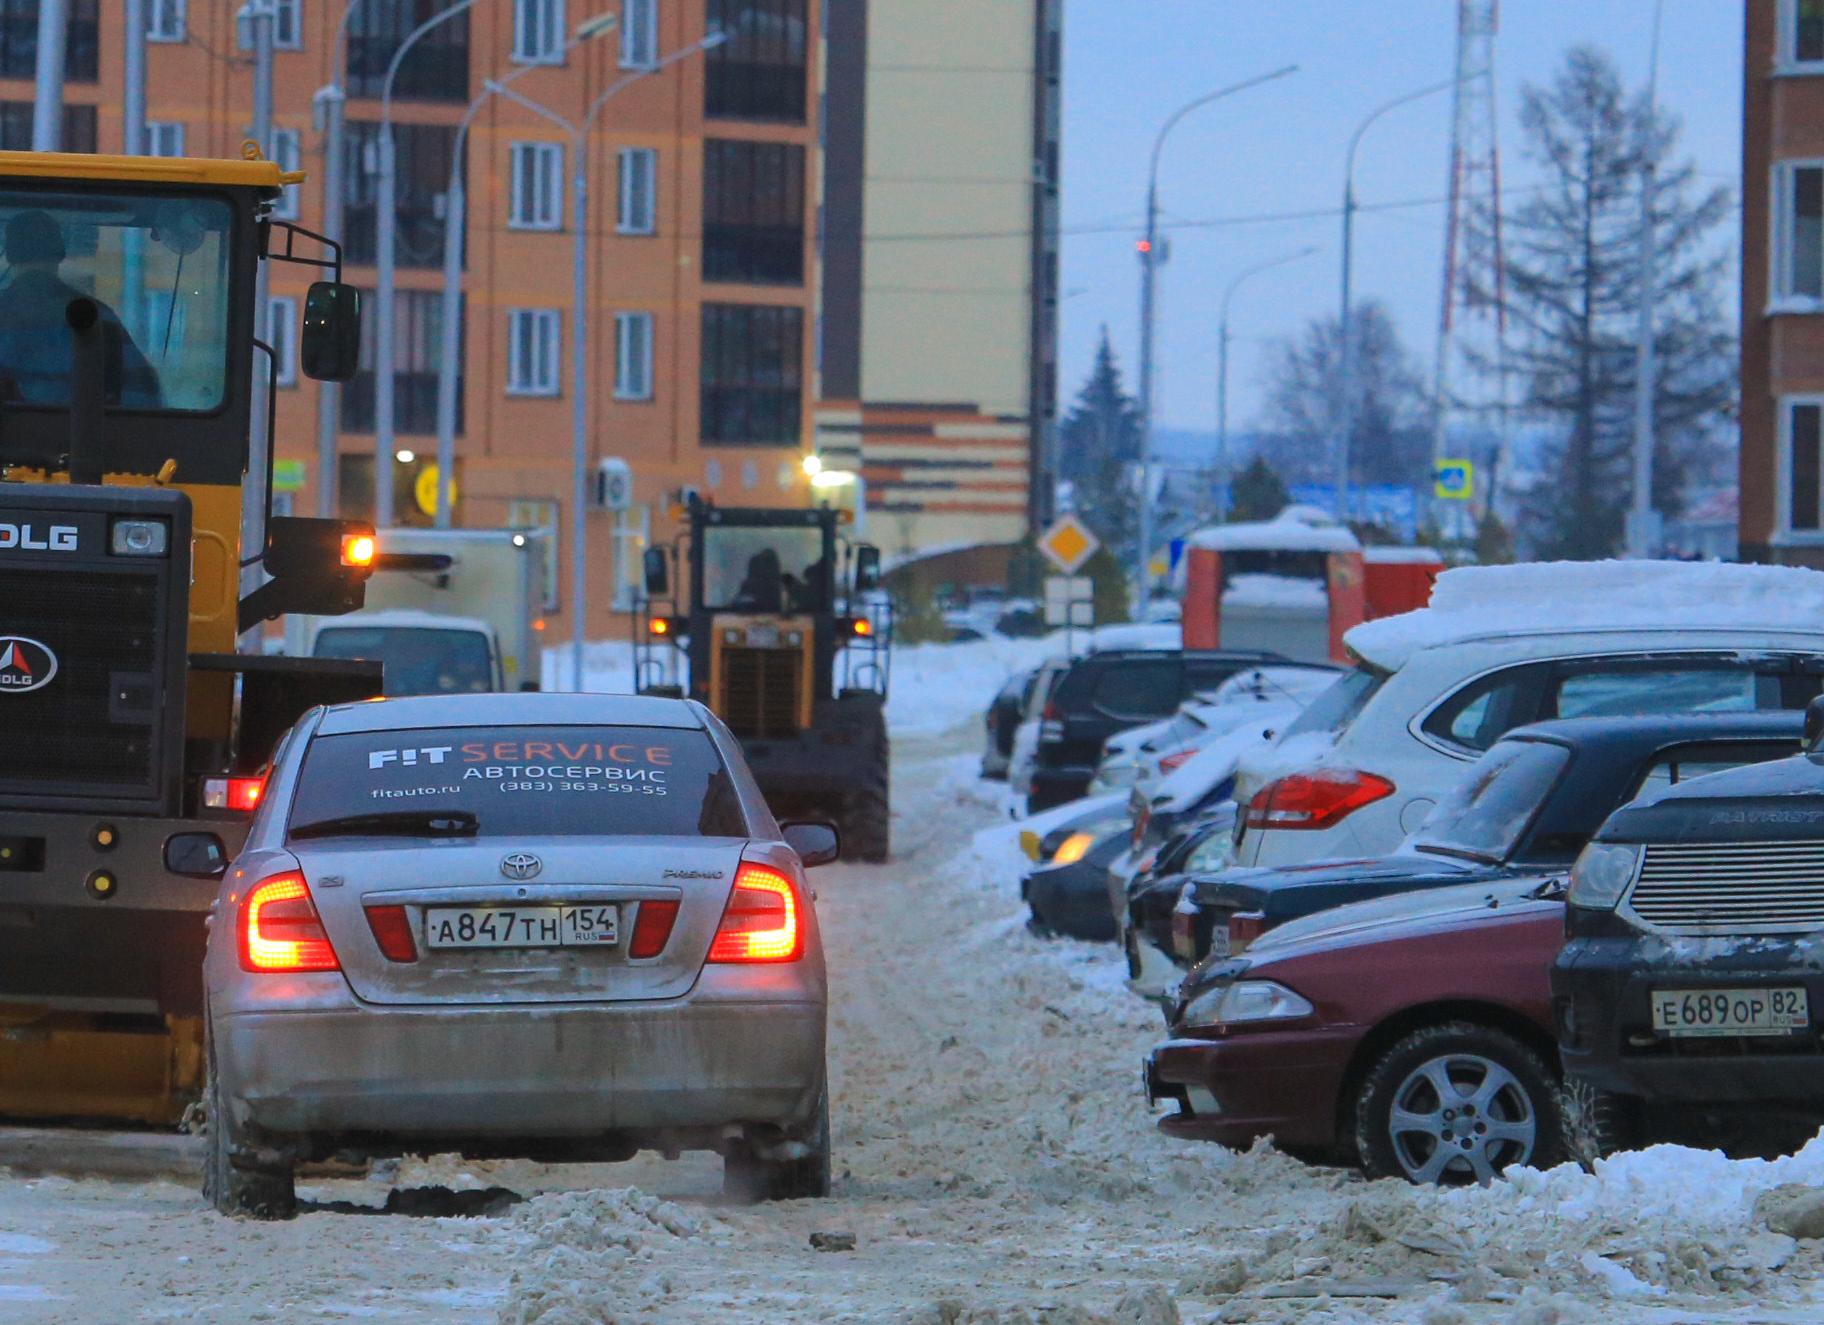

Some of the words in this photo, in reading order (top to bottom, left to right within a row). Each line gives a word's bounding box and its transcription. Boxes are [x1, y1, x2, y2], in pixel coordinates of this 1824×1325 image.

[461, 742, 672, 765] SERVICE
[463, 766, 665, 783] АВТОСЕРВИС
[371, 785, 460, 798] fitauto.ru
[499, 781, 553, 793] (383)
[560, 782, 667, 796] 363-59-55
[438, 912, 557, 942] А847ТН
[565, 909, 611, 932] 154
[576, 932, 598, 941] RUS
[1663, 994, 1764, 1025] Е689ОР
[1772, 991, 1798, 1014] 82
